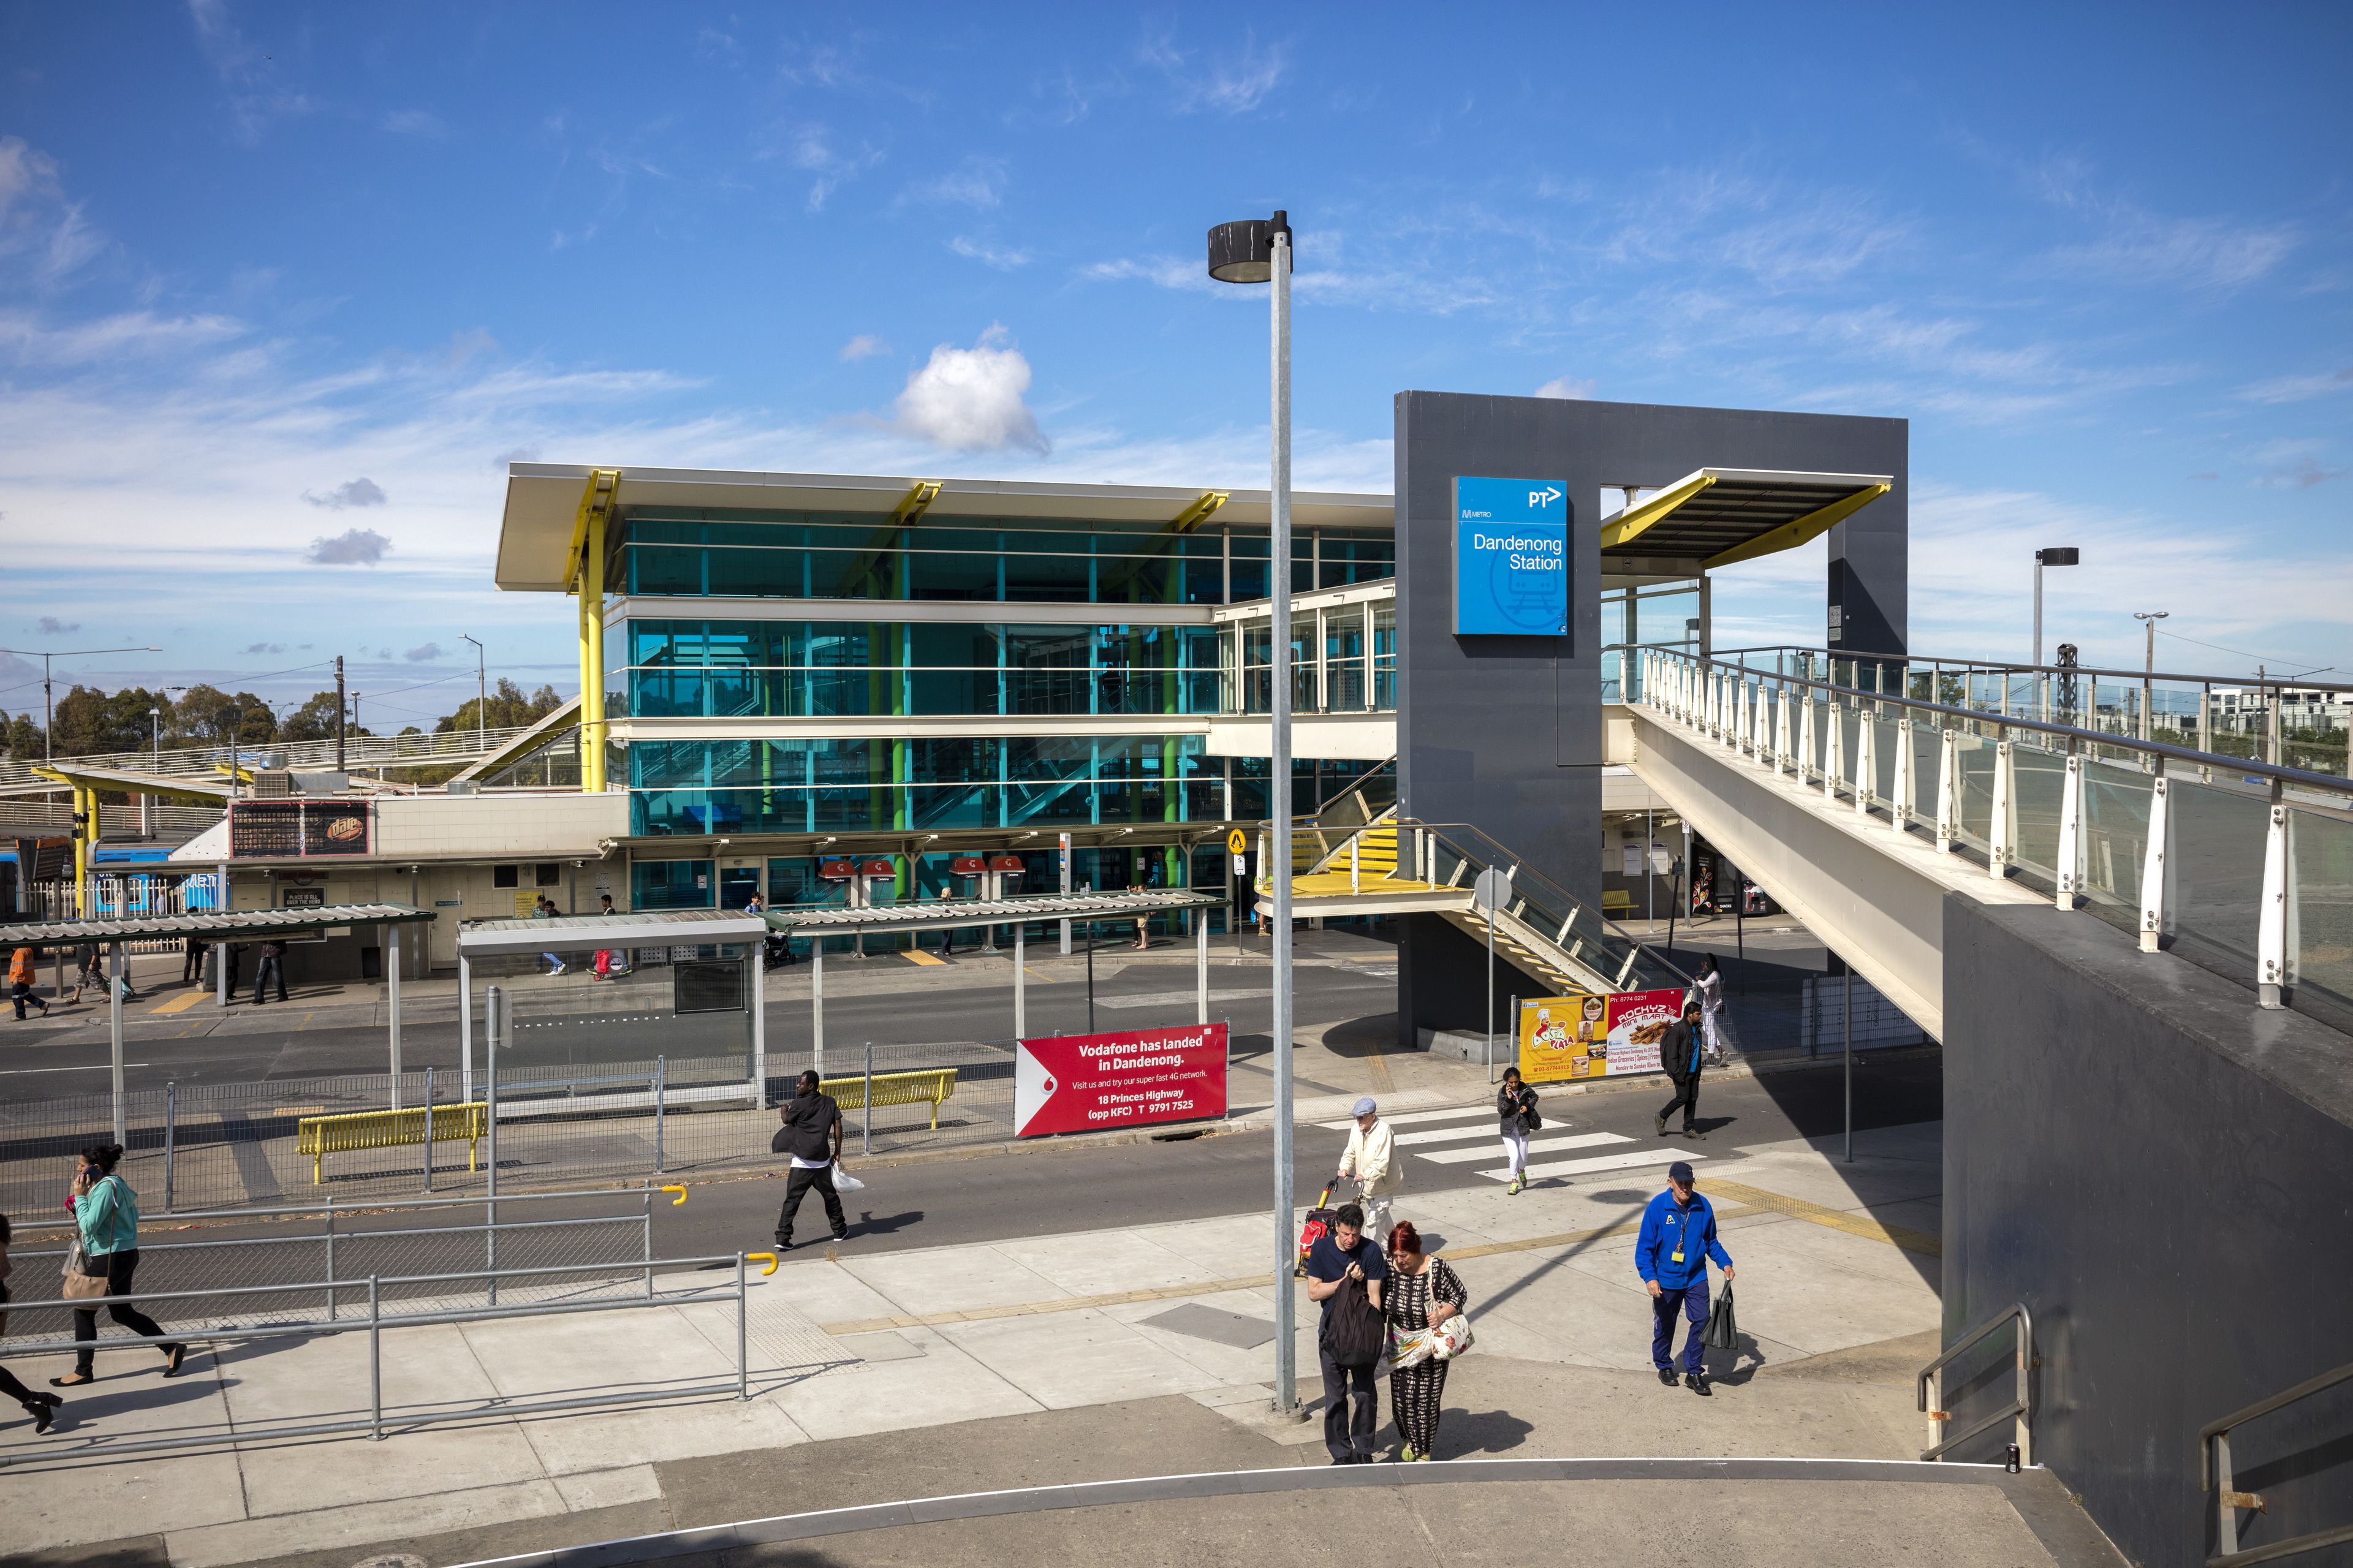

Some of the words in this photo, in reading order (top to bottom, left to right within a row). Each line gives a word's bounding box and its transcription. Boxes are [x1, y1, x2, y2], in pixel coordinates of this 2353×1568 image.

[1474, 534, 1562, 555] Dandenong
[1510, 554, 1562, 570] Station
[332, 817, 358, 836] dare
[1617, 1004, 1666, 1023] ROCKYZ
[1622, 1018, 1637, 1029] MINI
[1078, 1043, 1137, 1057] Vodafone
[1140, 1040, 1161, 1052] has
[1164, 1035, 1203, 1050] landed
[1532, 1029, 1566, 1047] DOSA
[1550, 1036, 1574, 1050] PLAZA
[1099, 1059, 1110, 1071] in
[1113, 1054, 1184, 1069] Dandenong.
[1072, 1081, 1087, 1089] Visit
[1098, 1079, 1111, 1088] and
[1112, 1078, 1122, 1087] try
[1180, 1070, 1207, 1080] network.
[1098, 1096, 1108, 1105] 18
[1110, 1094, 1144, 1104] Princes
[1146, 1089, 1184, 1101] Highway
[1088, 1110, 1108, 1121] (opp
[1110, 1106, 1132, 1117] KFC)
[1139, 1105, 1145, 1114] T
[1149, 1102, 1170, 1113] 9791
[1172, 1100, 1194, 1110] 7525
